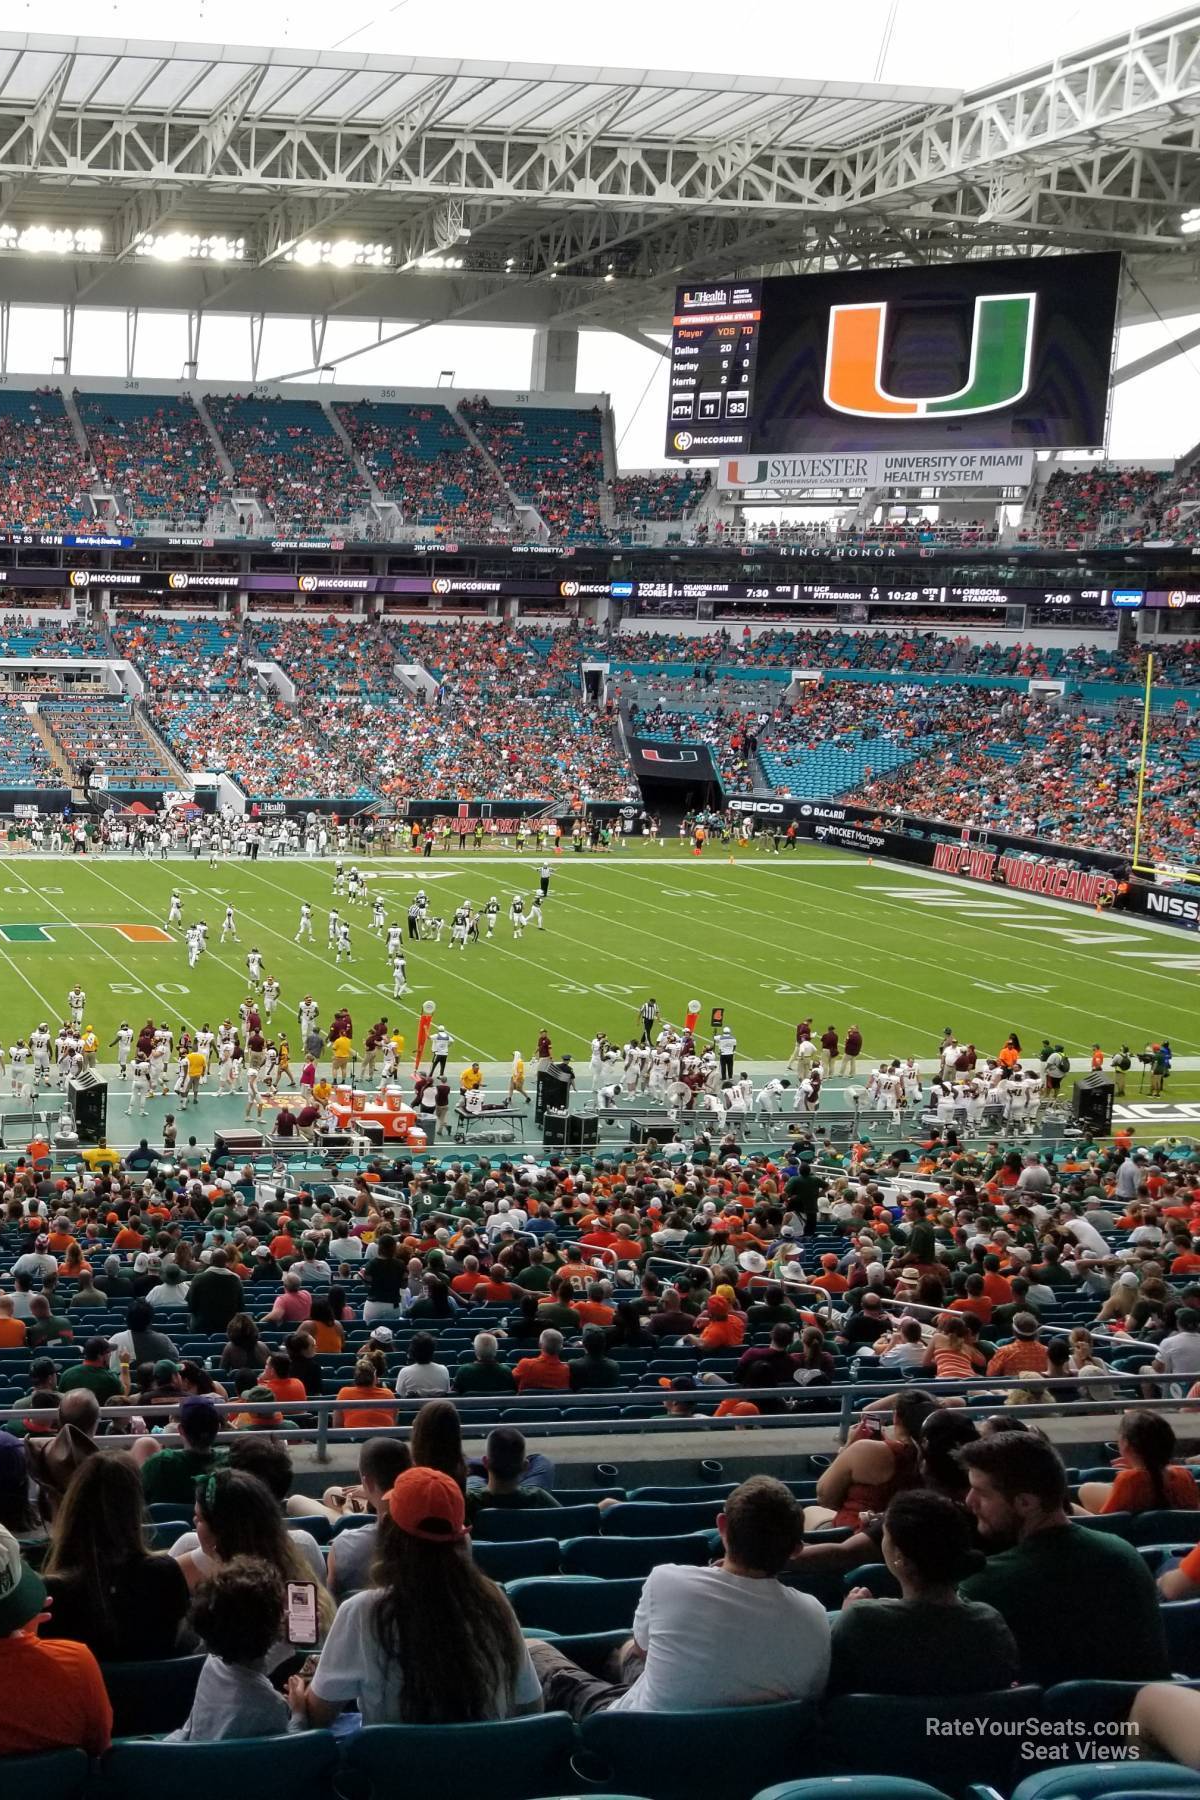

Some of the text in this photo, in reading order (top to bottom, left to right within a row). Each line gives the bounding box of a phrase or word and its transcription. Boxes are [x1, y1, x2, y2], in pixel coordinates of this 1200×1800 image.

[678, 326, 753, 339] Player YDS TD
[674, 342, 750, 355] Dallas 20 1
[823, 291, 1038, 419] U
[673, 359, 750, 372] Harley 0
[124, 380, 139, 390] 348
[672, 374, 749, 386] Harris 2 0
[253, 384, 269, 393] 349
[381, 389, 396, 398] 350
[516, 395, 530, 403] 351
[672, 405, 691, 415] 4TH
[704, 404, 715, 415] 11
[729, 402, 745, 413] 33
[693, 435, 743, 445] MICCOSUKEE
[884, 454, 1023, 469] UNIVERSITY OF MIAMI
[770, 459, 868, 478] SYLVESTER
[883, 470, 983, 483] HEALTH SYSTEM
[23, 536, 33, 545] 33
[271, 541, 297, 549] CORTEZ
[298, 541, 331, 550] KENNEDY
[530, 547, 563, 555] TORRETTA
[780, 547, 895, 557] RING HONOR
[90, 573, 141, 584] MICCOSUKEE
[188, 576, 239, 586] MICCOSUKEE
[318, 579, 368, 588] MICCOSUKEE
[451, 582, 501, 592] MICCOSUKEE
[683, 584, 712, 592] OKLAHOMA
[963, 588, 1000, 596] OREGON
[637, 589, 667, 597] SCORES
[683, 590, 707, 598] TEXAS
[746, 588, 769, 598] 7:30
[813, 592, 861, 600] PITTSBURGH
[887, 590, 918, 601] 10:28
[1044, 590, 1099, 604] 7:00 QTR
[962, 595, 1007, 603] STANFORD
[641, 748, 698, 764] U
[728, 799, 784, 814] GEICO
[829, 824, 856, 839] ROCKET
[855, 831, 886, 847] Mortgage
[932, 842, 996, 881] MIAMI
[108, 983, 191, 995] 50
[548, 982, 635, 996] 30
[760, 982, 850, 994] 20
[712, 1008, 722, 1022] 4
[391, 1116, 408, 1132] G
[422, 1194, 432, 1205] 8
